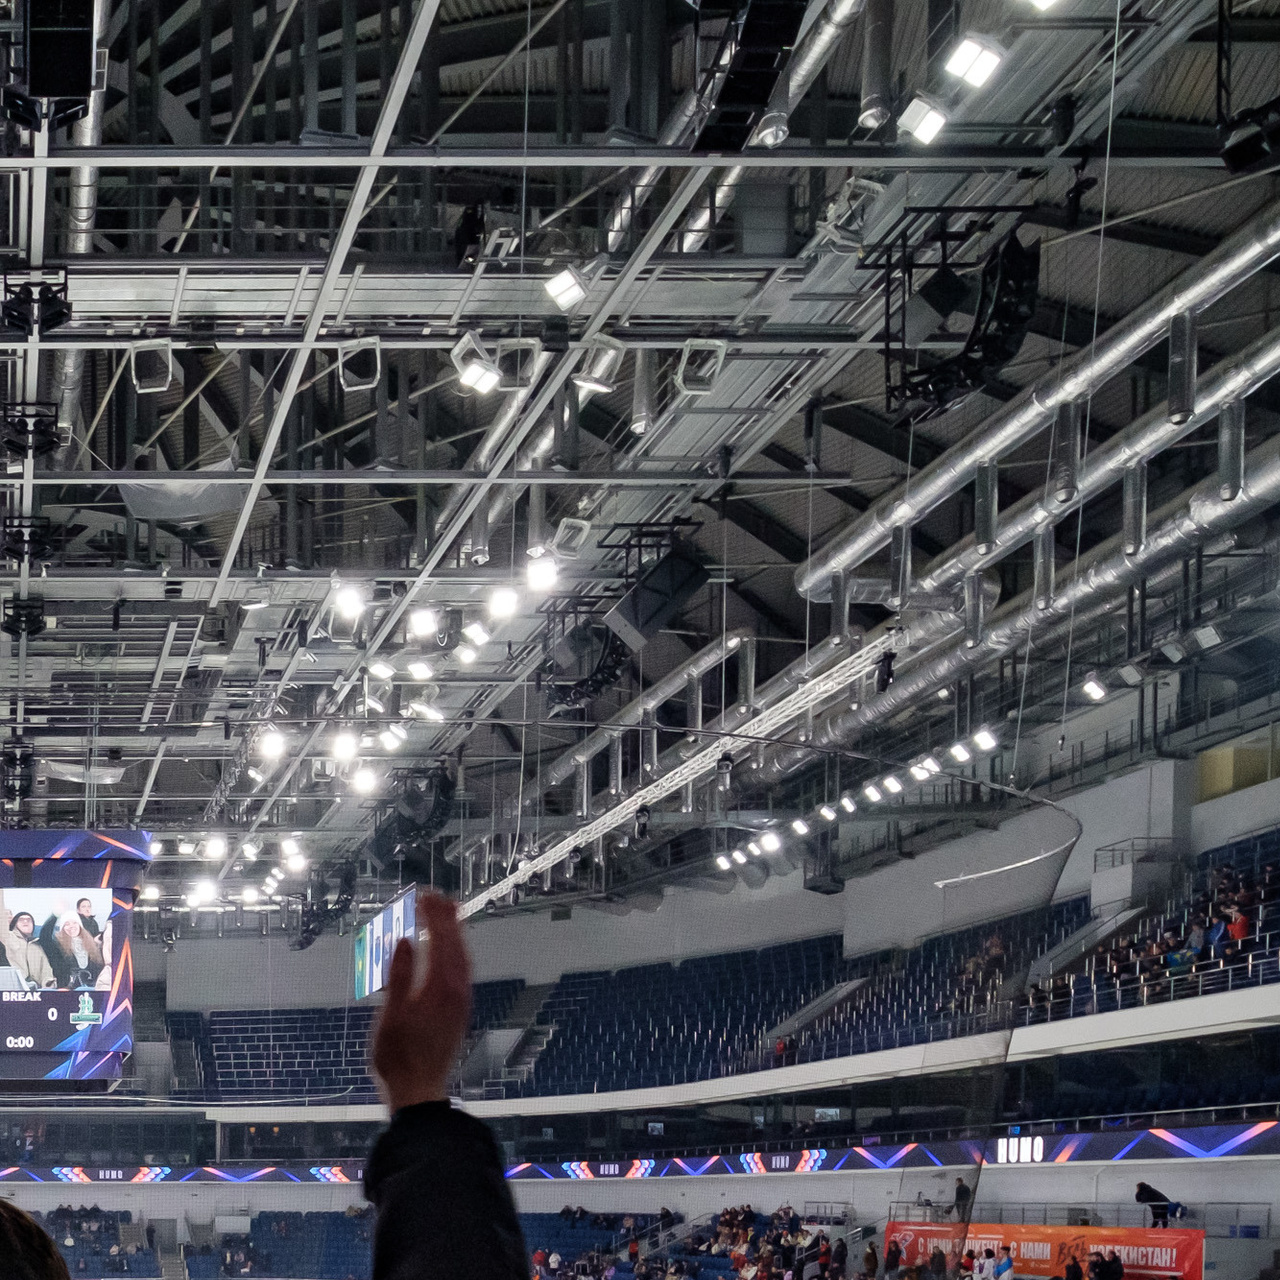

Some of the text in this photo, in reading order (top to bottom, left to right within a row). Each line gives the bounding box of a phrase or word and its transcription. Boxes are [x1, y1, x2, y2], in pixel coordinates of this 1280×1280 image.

[2, 991, 42, 1002] BREAK
[47, 1008, 58, 1021] 0
[6, 1036, 34, 1048] 0:00
[997, 1135, 1044, 1163] HUMO
[99, 1169, 123, 1179] HUMO
[600, 1163, 619, 1175] HUMO
[1020, 1241, 1051, 1260] НАМИ
